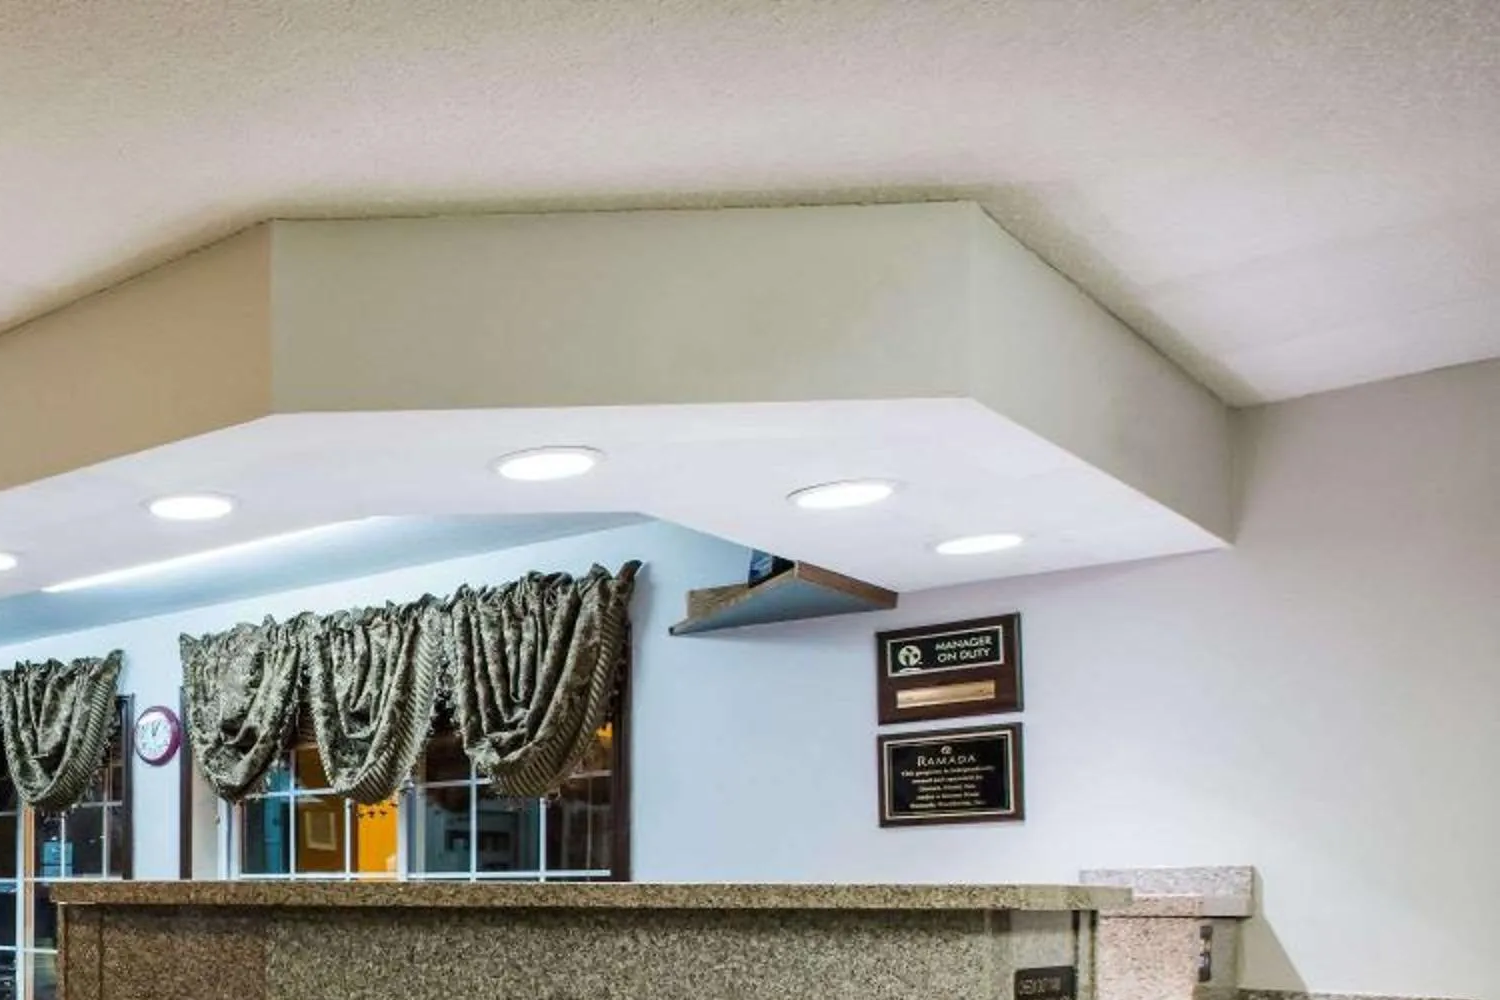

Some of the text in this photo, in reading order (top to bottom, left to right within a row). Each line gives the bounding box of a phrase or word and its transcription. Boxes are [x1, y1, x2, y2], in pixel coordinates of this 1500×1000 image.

[935, 635, 993, 651] MANAGER
[937, 647, 991, 663] ON DUTY
[916, 754, 976, 767] RAMADA
